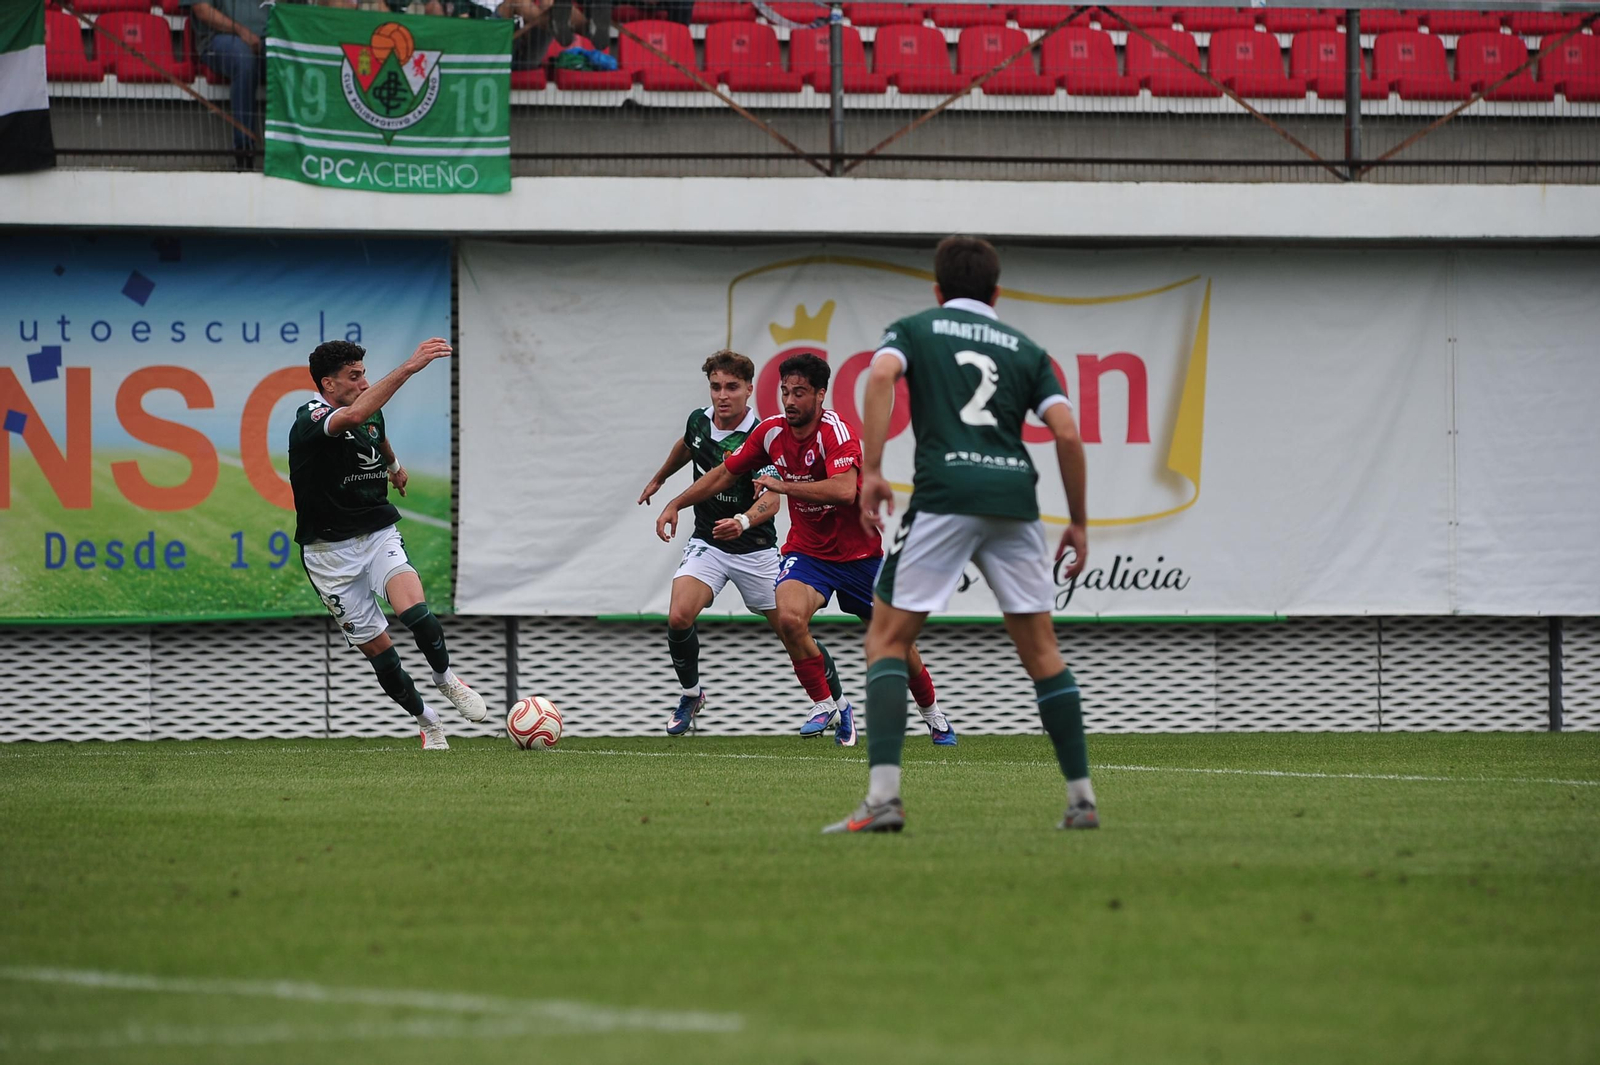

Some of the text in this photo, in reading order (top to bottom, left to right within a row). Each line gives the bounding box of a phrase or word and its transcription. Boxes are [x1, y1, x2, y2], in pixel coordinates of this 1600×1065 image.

[279, 64, 327, 124] 19
[450, 77, 499, 134] 19
[301, 154, 479, 189] CPCACEREÑO
[19, 311, 363, 343] utoescuela
[932, 319, 1019, 352] MARTÍNEZ
[954, 349, 1000, 427] 2
[715, 492, 738, 503] dura
[45, 530, 291, 570] Desde 19
[784, 556, 799, 570] 6
[1054, 549, 1190, 611] Galicia
